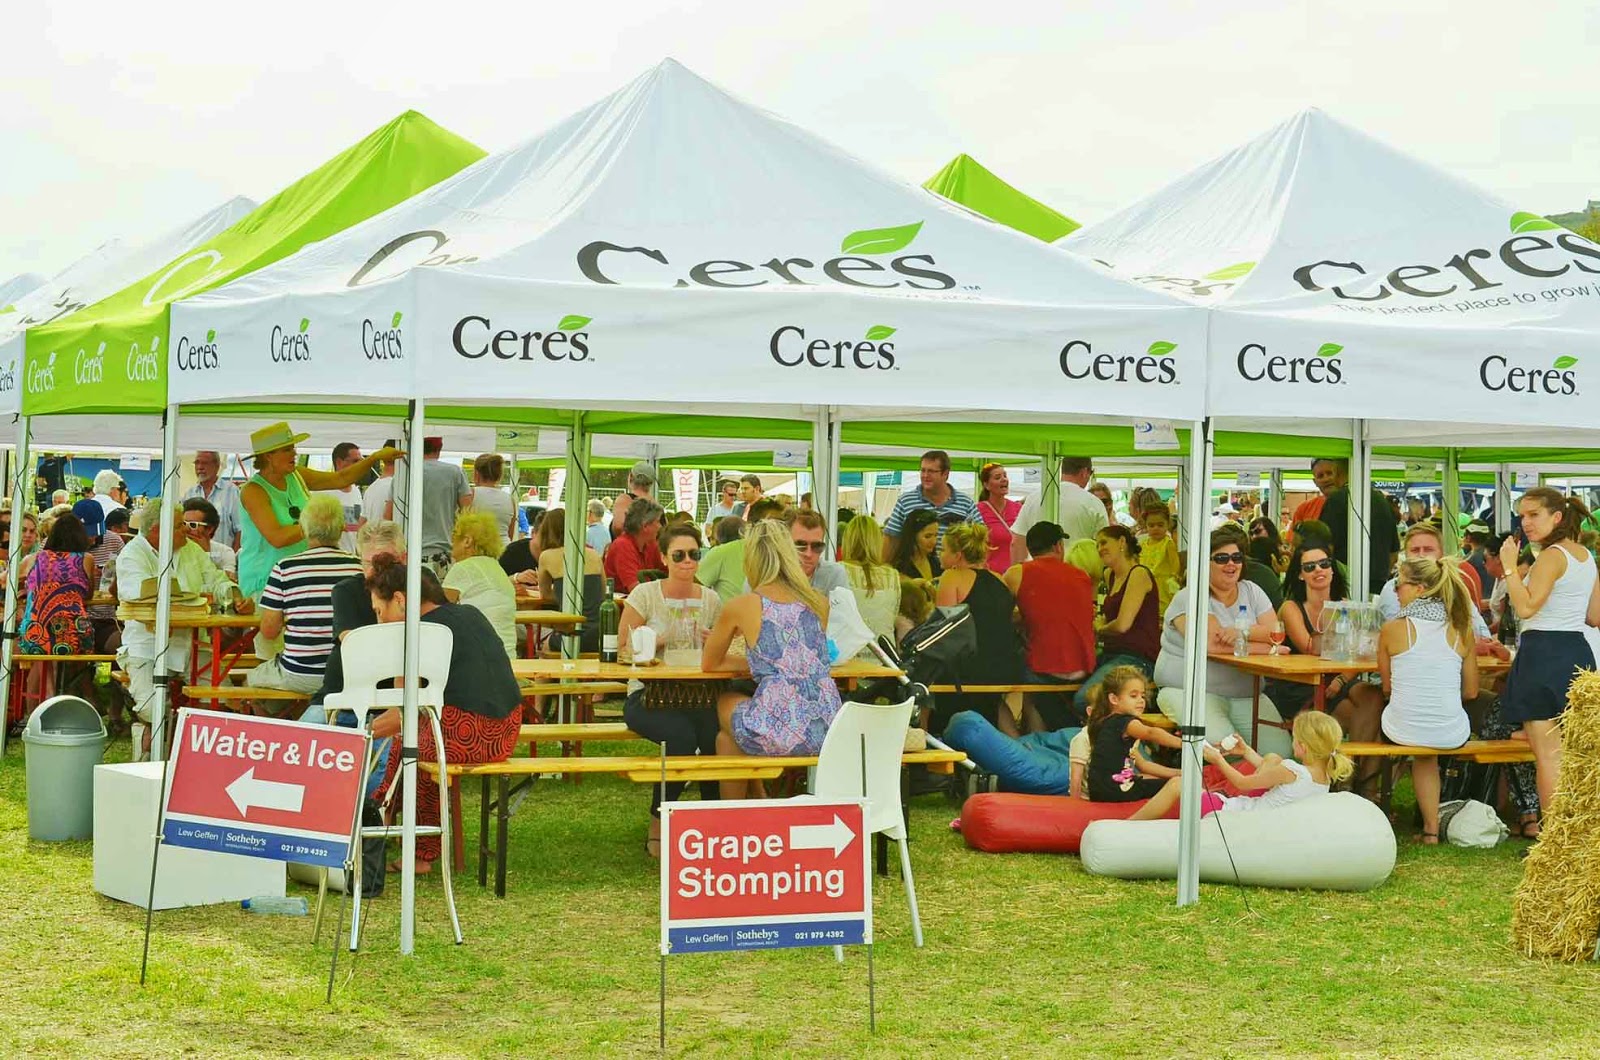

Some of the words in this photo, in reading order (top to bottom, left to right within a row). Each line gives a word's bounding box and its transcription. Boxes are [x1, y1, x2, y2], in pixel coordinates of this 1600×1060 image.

[1455, 296, 1511, 314] place
[1513, 291, 1537, 304] to
[1541, 286, 1591, 302] grow
[177, 335, 218, 370] Ceres
[270, 325, 309, 363] Ceres
[362, 318, 402, 360] Ceres
[453, 315, 589, 362] Ceres
[769, 325, 895, 370] Ceres
[0, 366, 14, 391] eres
[1059, 340, 1176, 384] Ceres
[1237, 343, 1342, 384] Ceres
[1479, 355, 1576, 396] Ceres
[190, 724, 281, 762] Water
[282, 742, 301, 766] &
[307, 739, 356, 773] Ice
[177, 827, 195, 837] Lew
[194, 829, 220, 841] Geffen
[226, 832, 268, 848] Sotheby's
[281, 844, 294, 853] 021
[678, 828, 784, 864] Grape
[677, 863, 845, 900] Stomping
[685, 934, 702, 944] Lew
[702, 932, 729, 943] Geffen
[736, 929, 779, 941] Sotheby's
[794, 931, 808, 940] 021
[810, 931, 824, 940] 979
[825, 930, 844, 939] 4392
